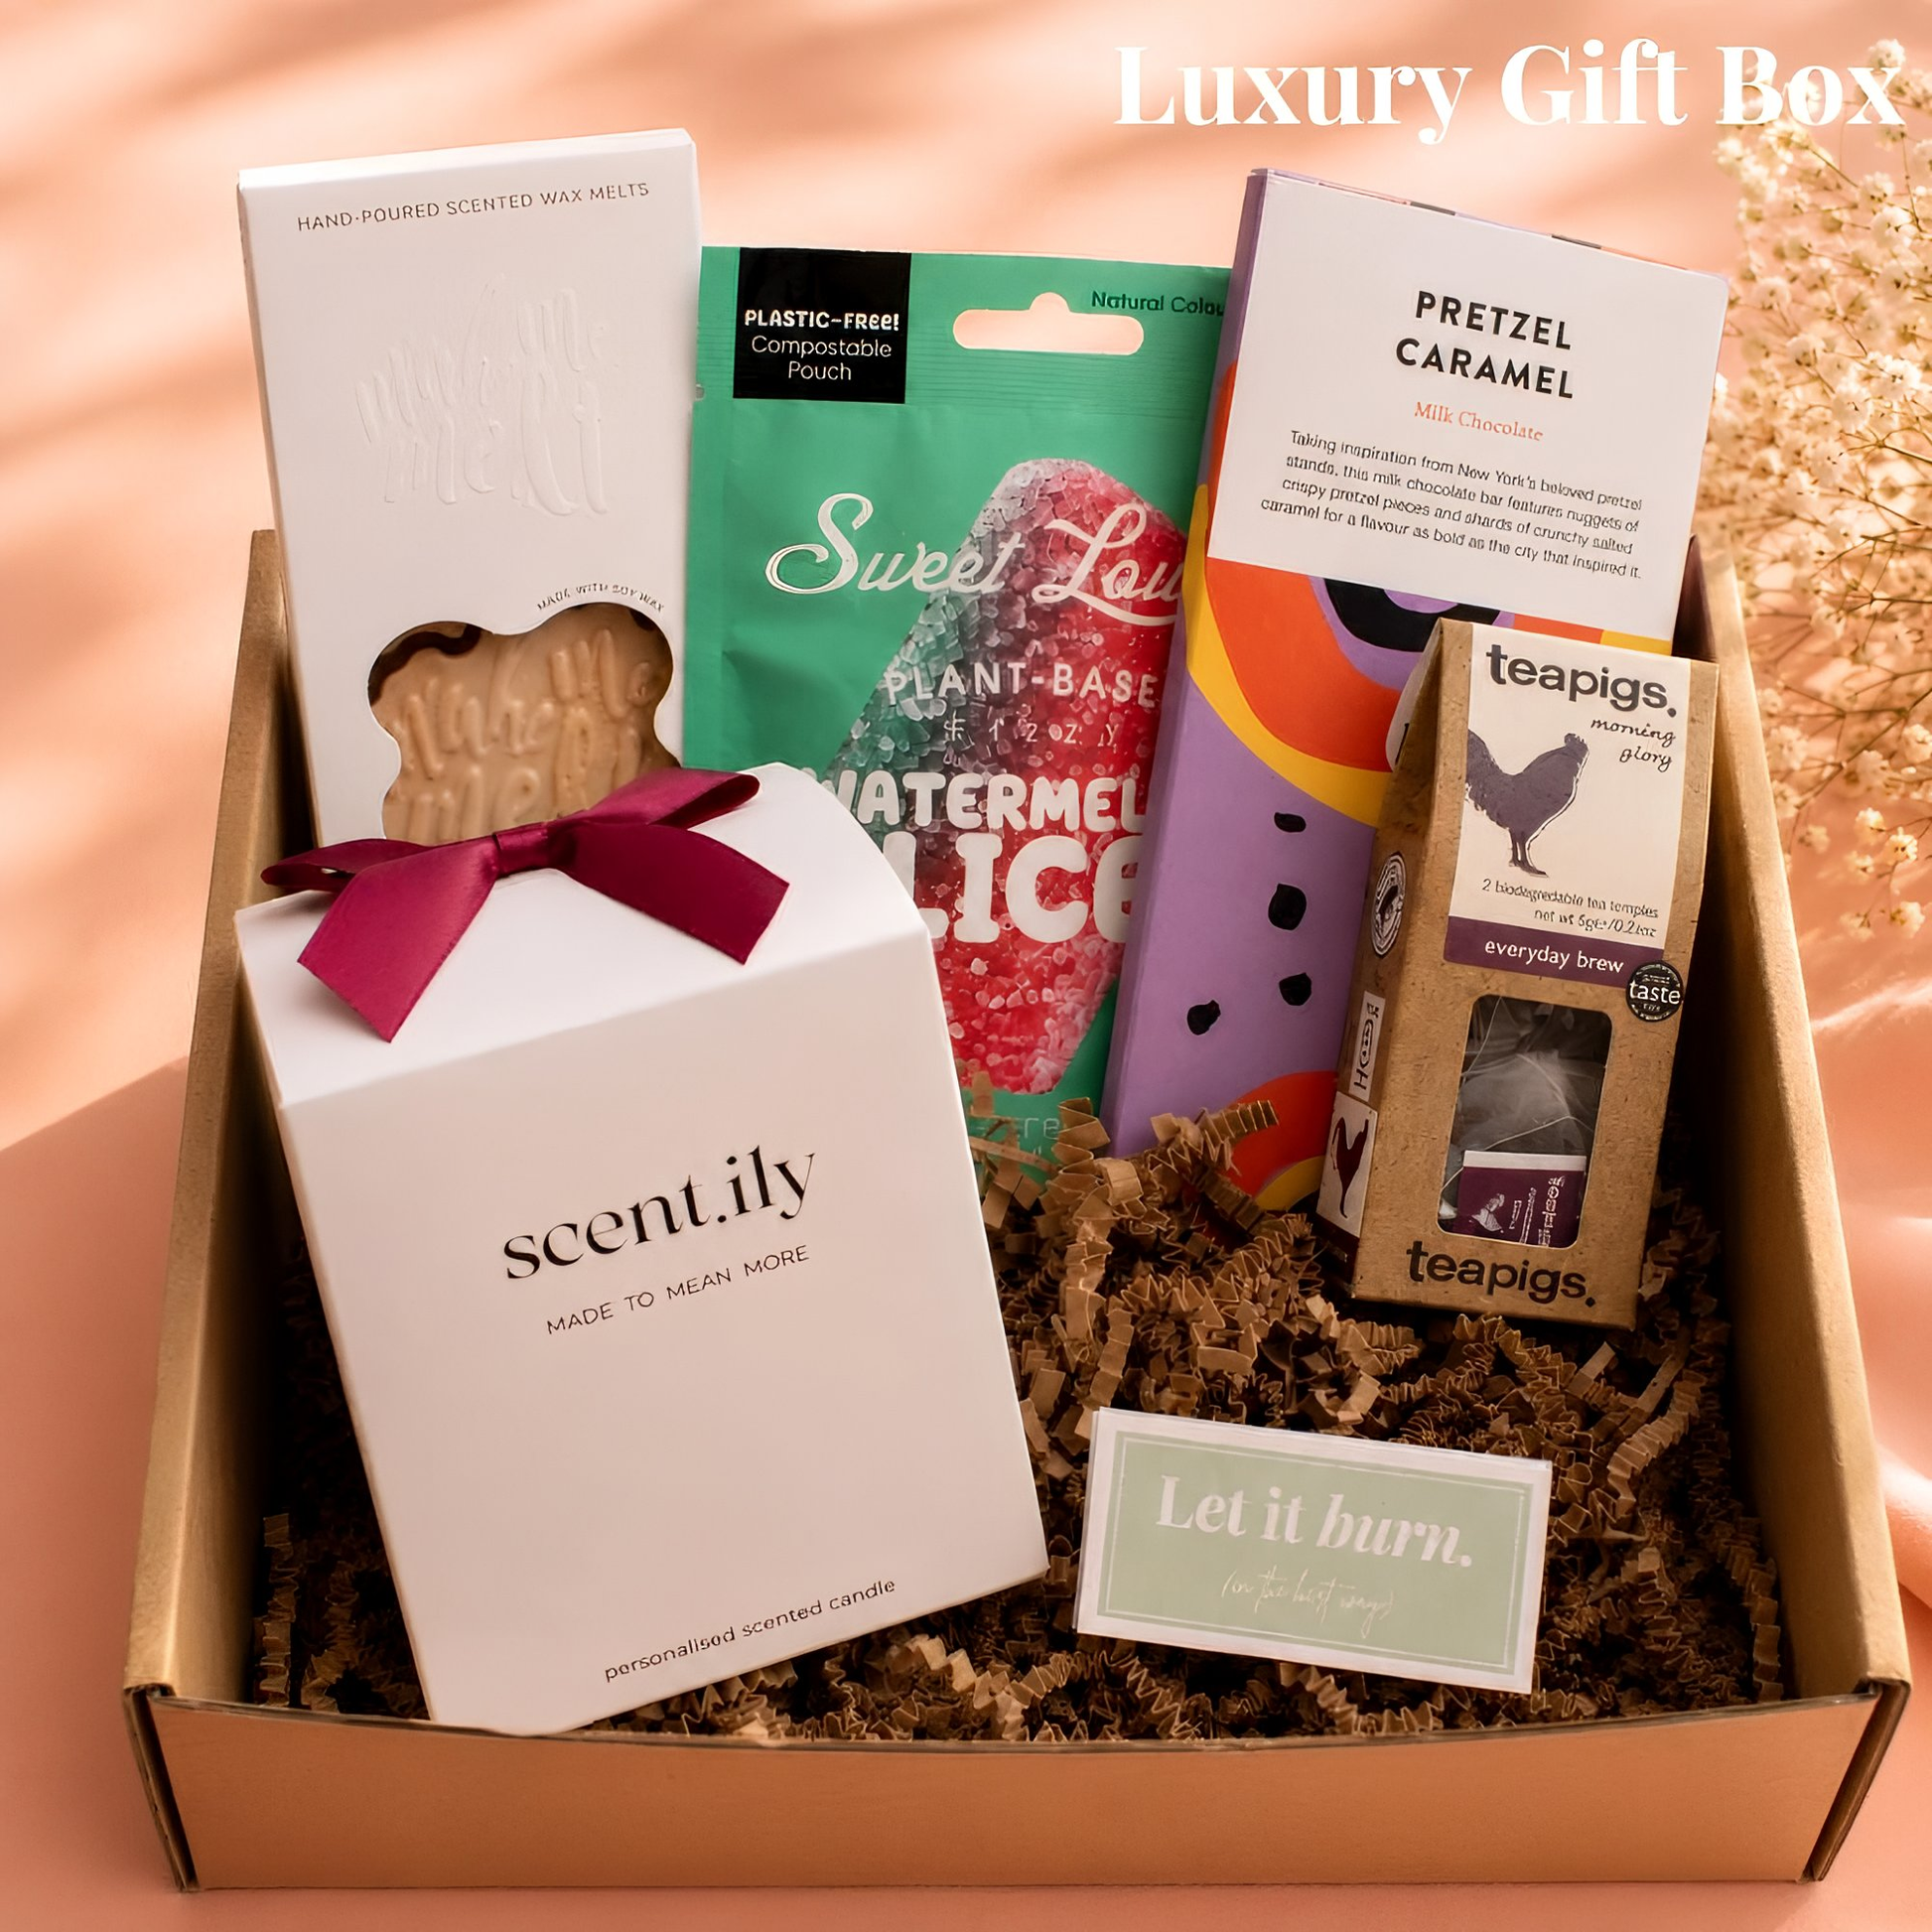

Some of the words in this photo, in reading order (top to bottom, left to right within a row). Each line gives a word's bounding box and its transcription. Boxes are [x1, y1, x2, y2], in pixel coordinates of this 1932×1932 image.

[446, 194, 533, 215] SCENTED
[540, 189, 583, 206] WAX
[589, 183, 649, 202] MELTS
[1091, 290, 1165, 311] Natural
[1416, 290, 1571, 350] PRETZEL
[751, 335, 892, 358] Compostable
[788, 360, 852, 381] Pouch
[1396, 338, 1574, 399] CARAMEL
[1414, 401, 1453, 424] Milk
[1458, 410, 1544, 441] Chocolate
[1421, 455, 1453, 475] from
[1260, 497, 1319, 519] caramel
[1323, 505, 1343, 523] for
[1347, 513, 1356, 526] a
[1360, 513, 1410, 535] flavour
[1413, 525, 1430, 539] as
[1434, 528, 1465, 546] bold
[1514, 544, 1539, 563] city
[1543, 549, 1569, 566] that
[1372, 472, 1402, 486] milk
[1406, 478, 1476, 501] chocolate
[1480, 489, 1503, 506] bar
[1625, 519, 1639, 533] of
[1434, 505, 1461, 523] and
[1516, 521, 1531, 534] of
[763, 491, 1026, 596] Sweet
[1485, 644, 1678, 718] teapigs.
[1481, 878, 1492, 893] 2
[1485, 939, 1571, 970] everyday
[1577, 951, 1624, 974] brew
[1629, 979, 1681, 1005] taste
[502, 1144, 817, 1281] scent.ily
[546, 1301, 615, 1335] MADE
[623, 1291, 655, 1312] TO
[666, 1267, 733, 1301] MEAN
[744, 1244, 811, 1279] MORE
[1406, 1240, 1596, 1309] teapigs.
[1156, 1474, 1253, 1537] Let
[1260, 1486, 1308, 1545] it
[1316, 1492, 1473, 1569] burn.
[742, 1599, 823, 1638] scented
[829, 1580, 896, 1611] candle
